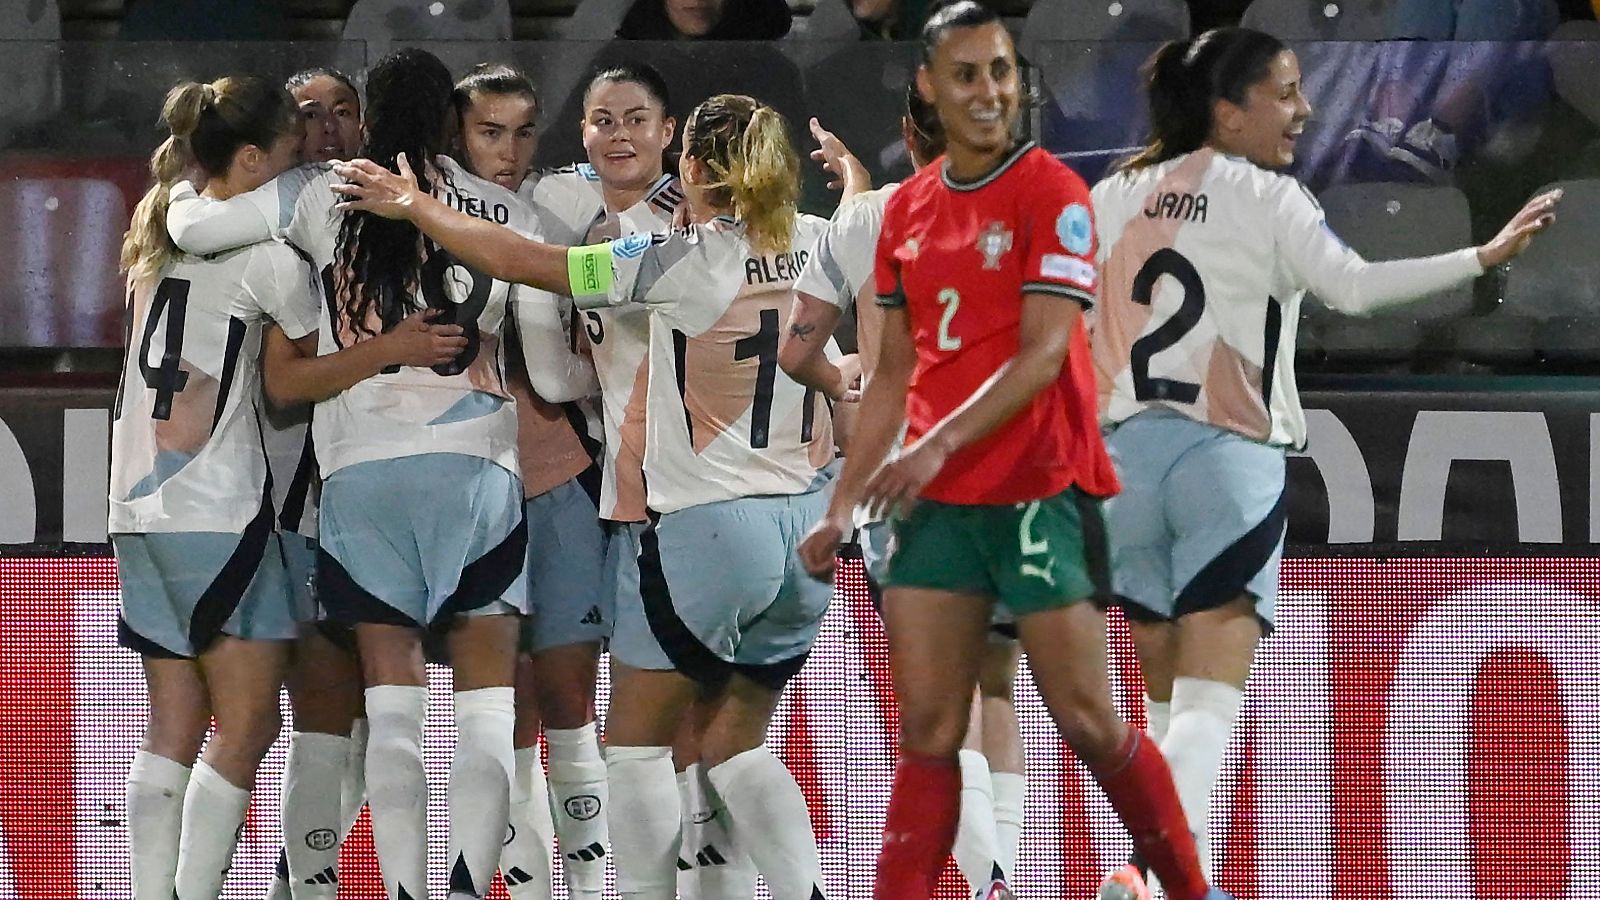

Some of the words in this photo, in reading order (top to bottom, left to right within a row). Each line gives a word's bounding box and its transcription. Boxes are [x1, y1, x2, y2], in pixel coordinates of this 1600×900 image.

[1144, 192, 1208, 223] JANA
[936, 288, 962, 352] 2
[1131, 247, 1206, 404] 2
